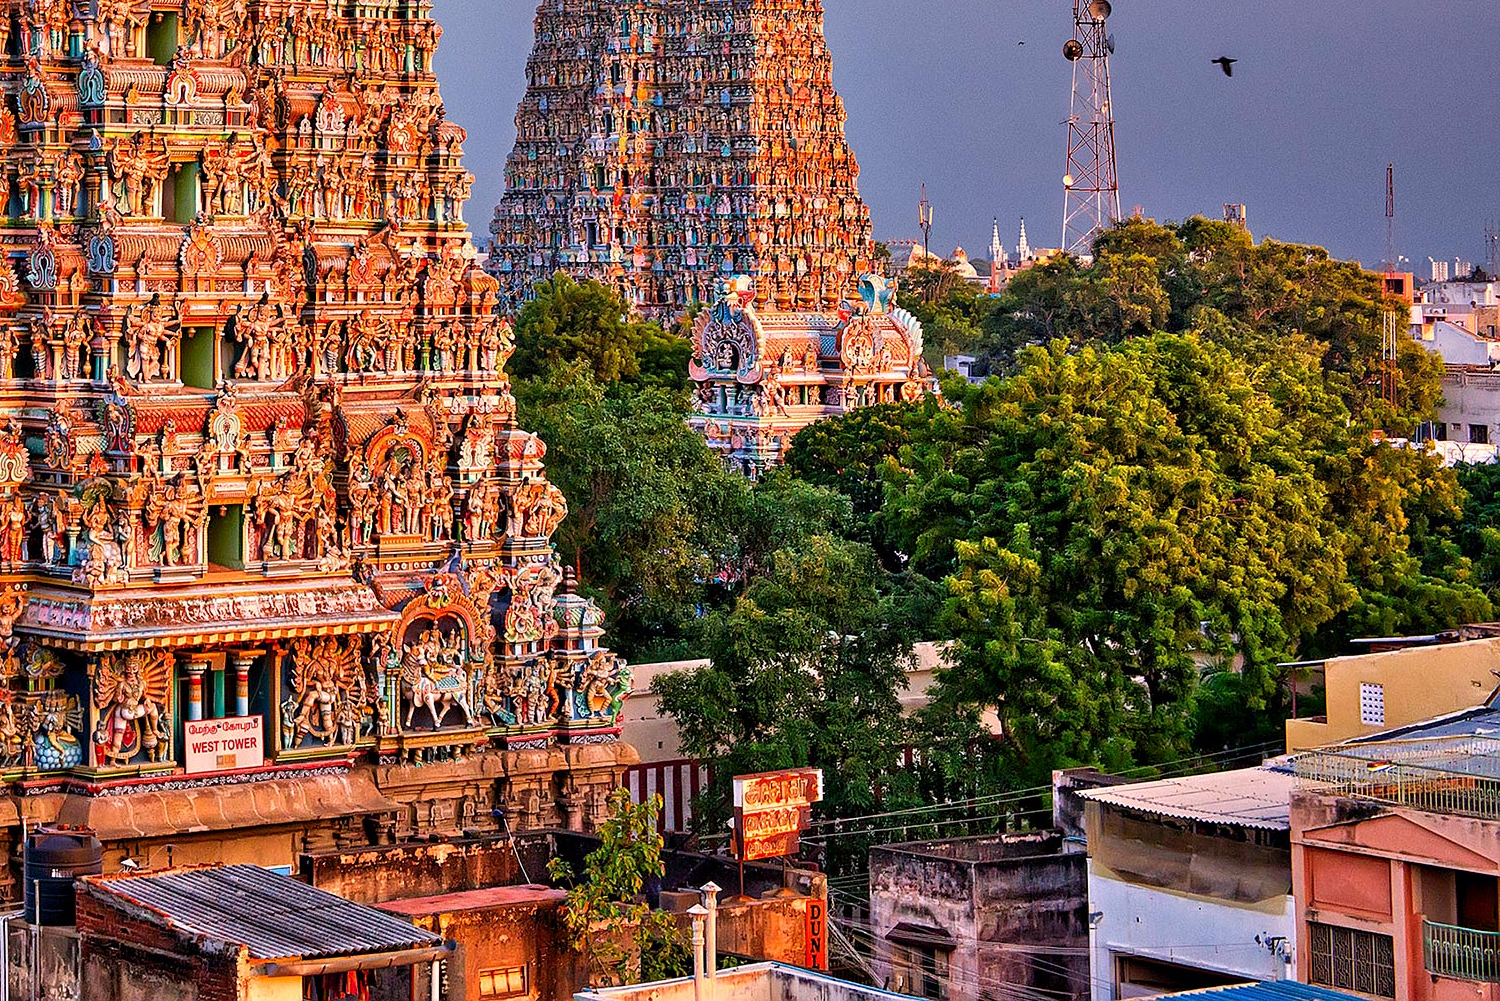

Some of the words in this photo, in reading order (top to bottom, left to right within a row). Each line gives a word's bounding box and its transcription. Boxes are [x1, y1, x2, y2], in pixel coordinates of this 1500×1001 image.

[188, 724, 218, 736] மேற்கு
[222, 719, 259, 732] கோபுரம்
[192, 741, 219, 754] WEST
[222, 737, 257, 751] TOWER
